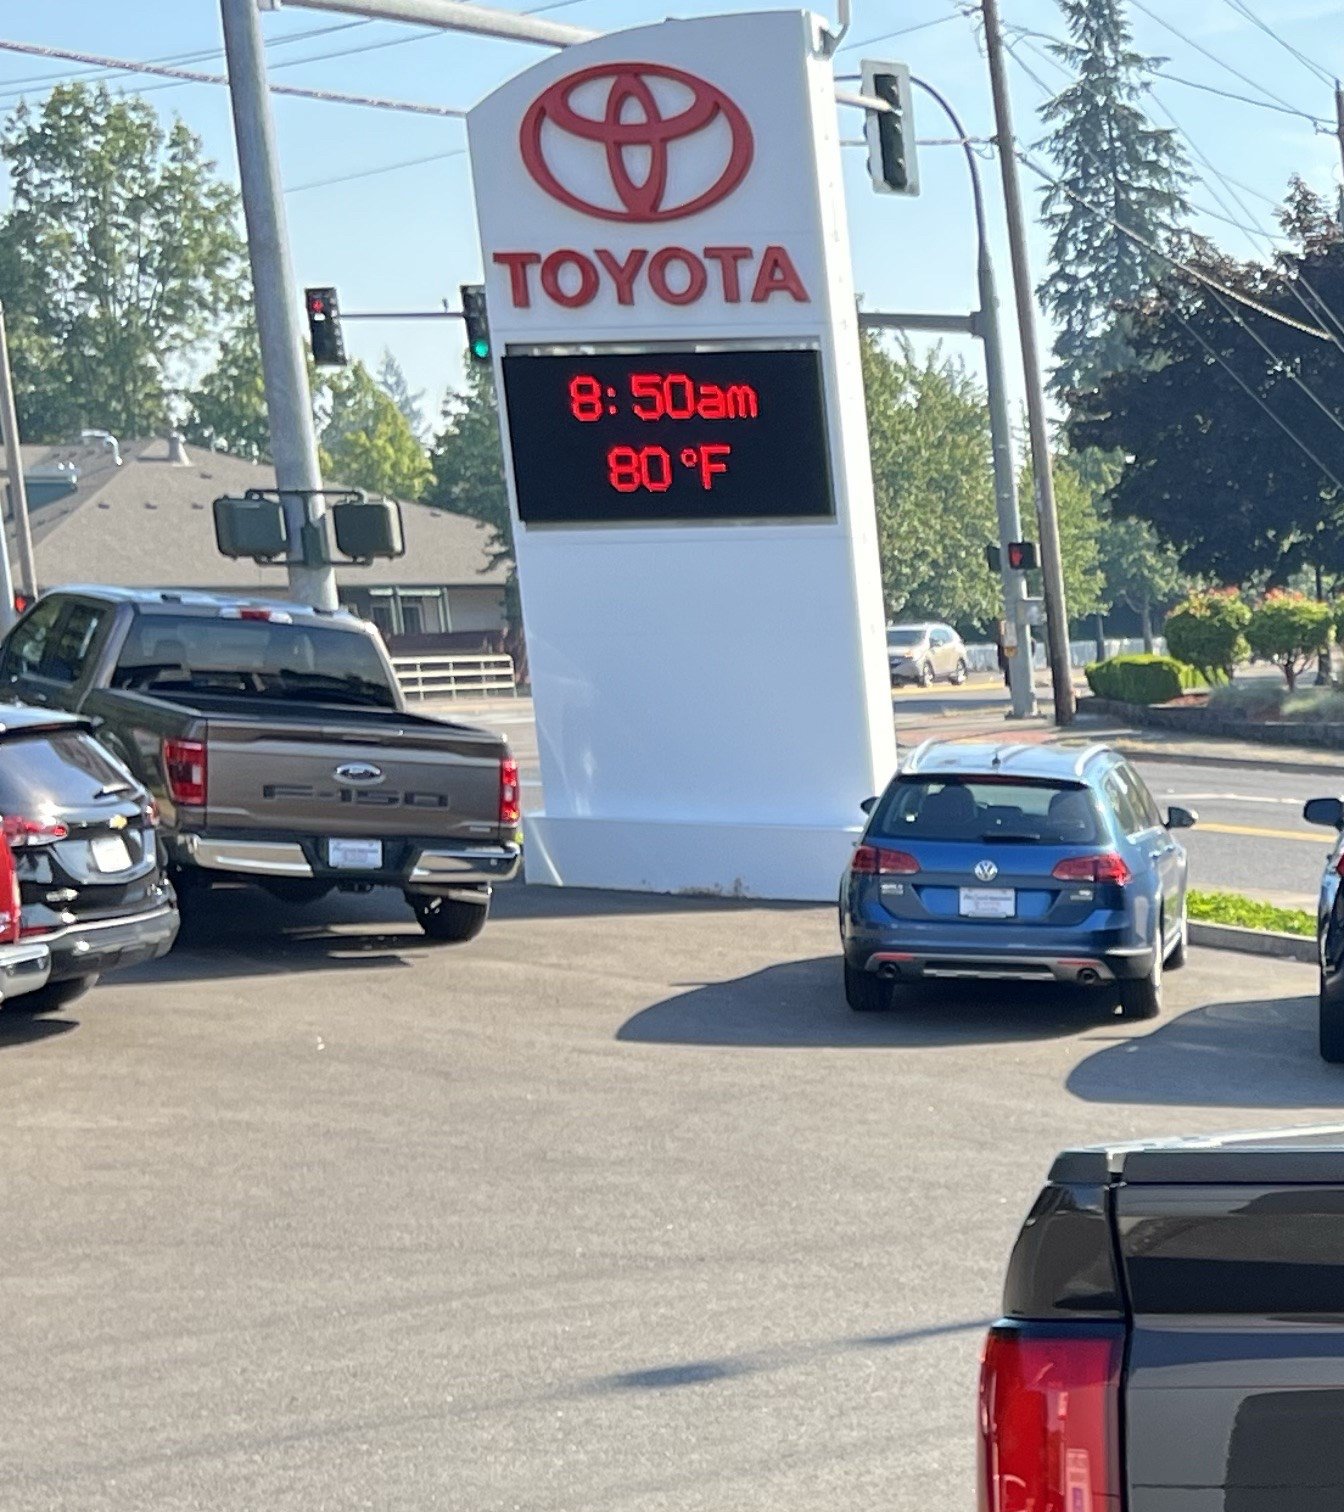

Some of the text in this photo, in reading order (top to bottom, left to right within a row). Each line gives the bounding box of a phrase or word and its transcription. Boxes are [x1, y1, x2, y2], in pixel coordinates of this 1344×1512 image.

[493, 245, 811, 309] TOYOTA
[569, 373, 759, 422] 8:50am
[262, 785, 448, 807] F-150
